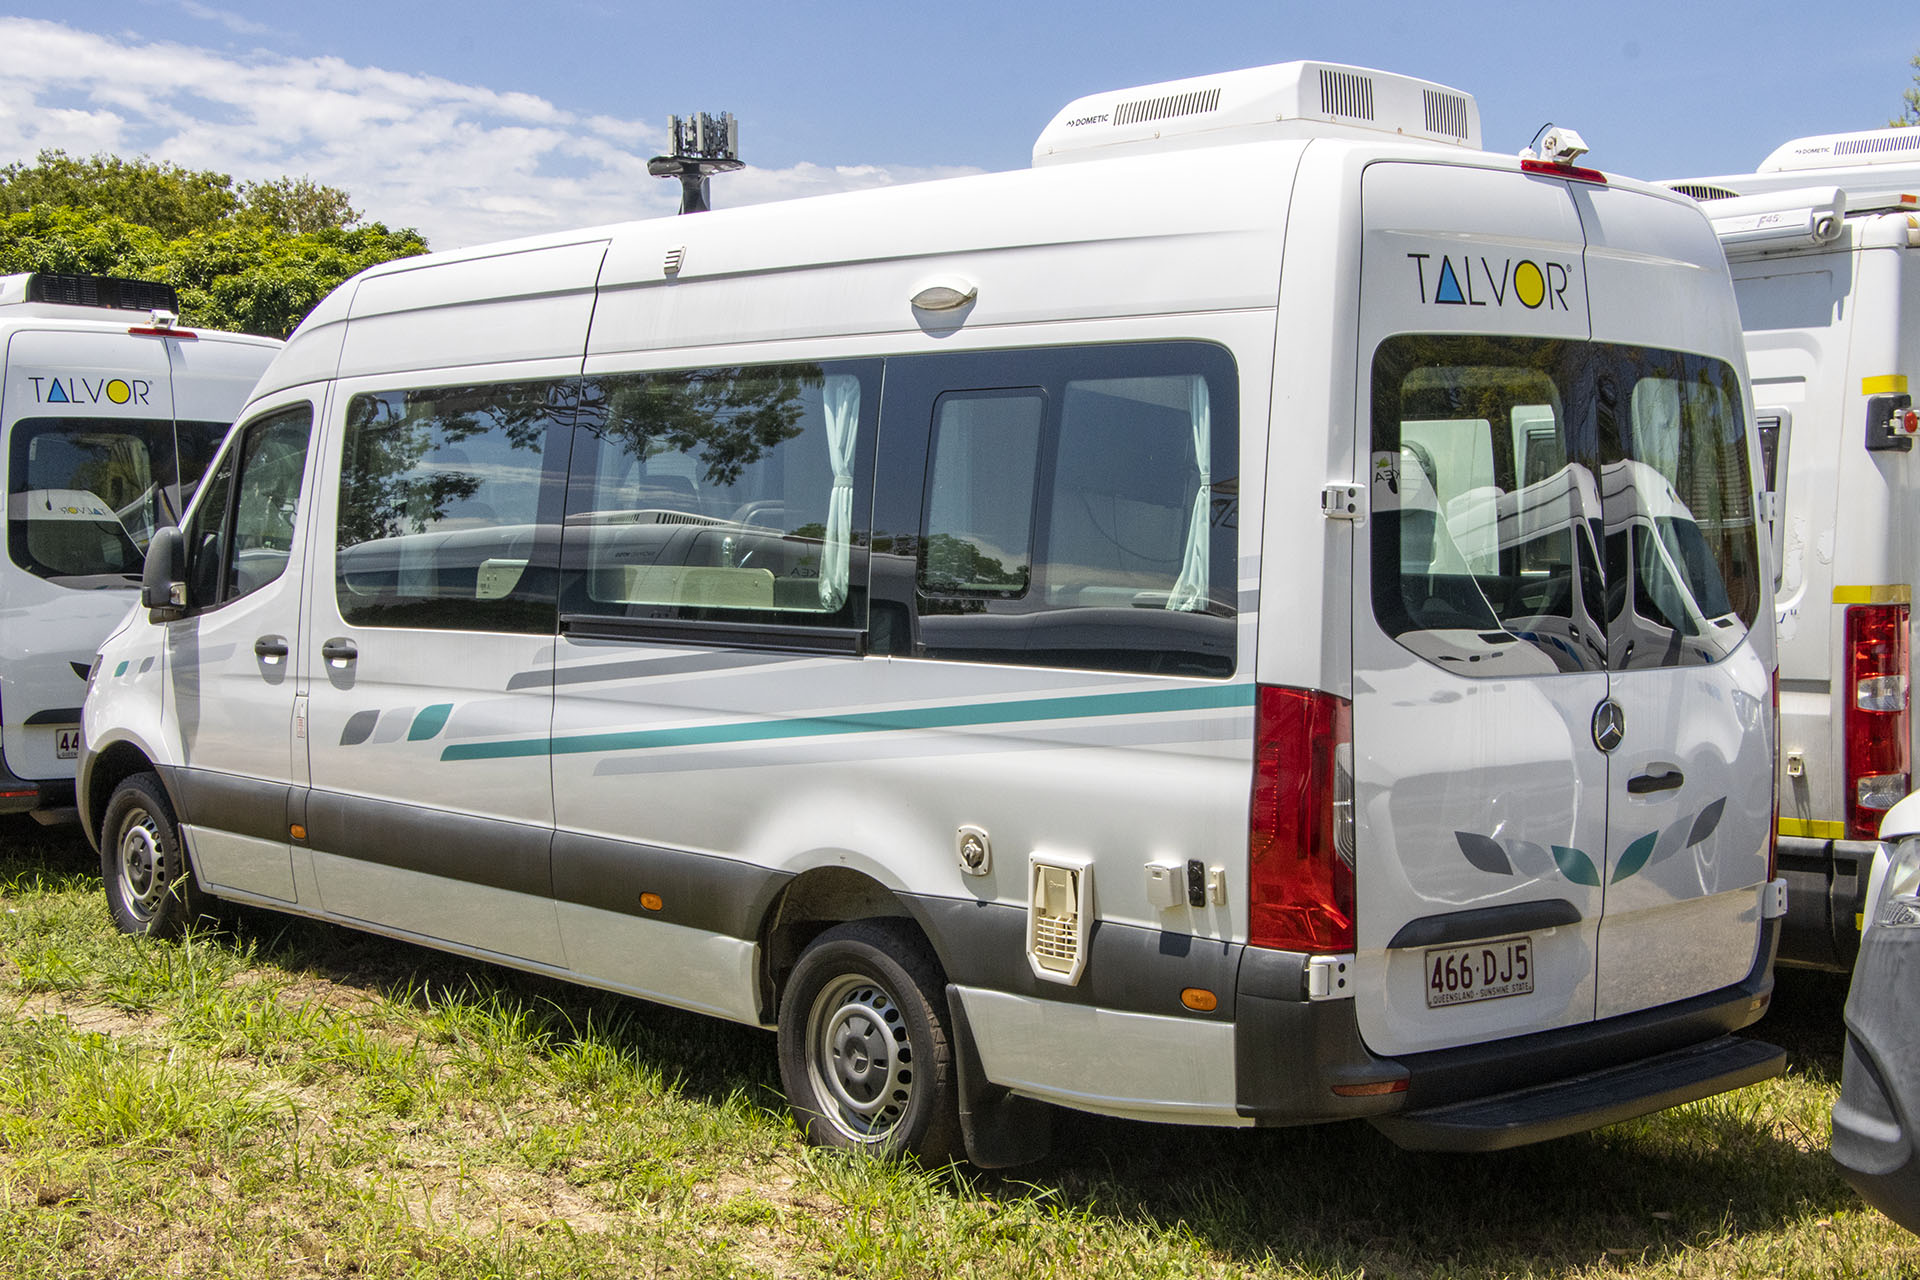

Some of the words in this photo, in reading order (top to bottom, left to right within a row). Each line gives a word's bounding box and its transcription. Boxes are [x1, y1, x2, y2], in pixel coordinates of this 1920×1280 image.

[1075, 114, 1109, 126] DOMETIC
[1433, 991, 1475, 1004] QUEENSLAND
[1480, 985, 1509, 997] SUNSHINE
[1512, 982, 1529, 991] STATE
